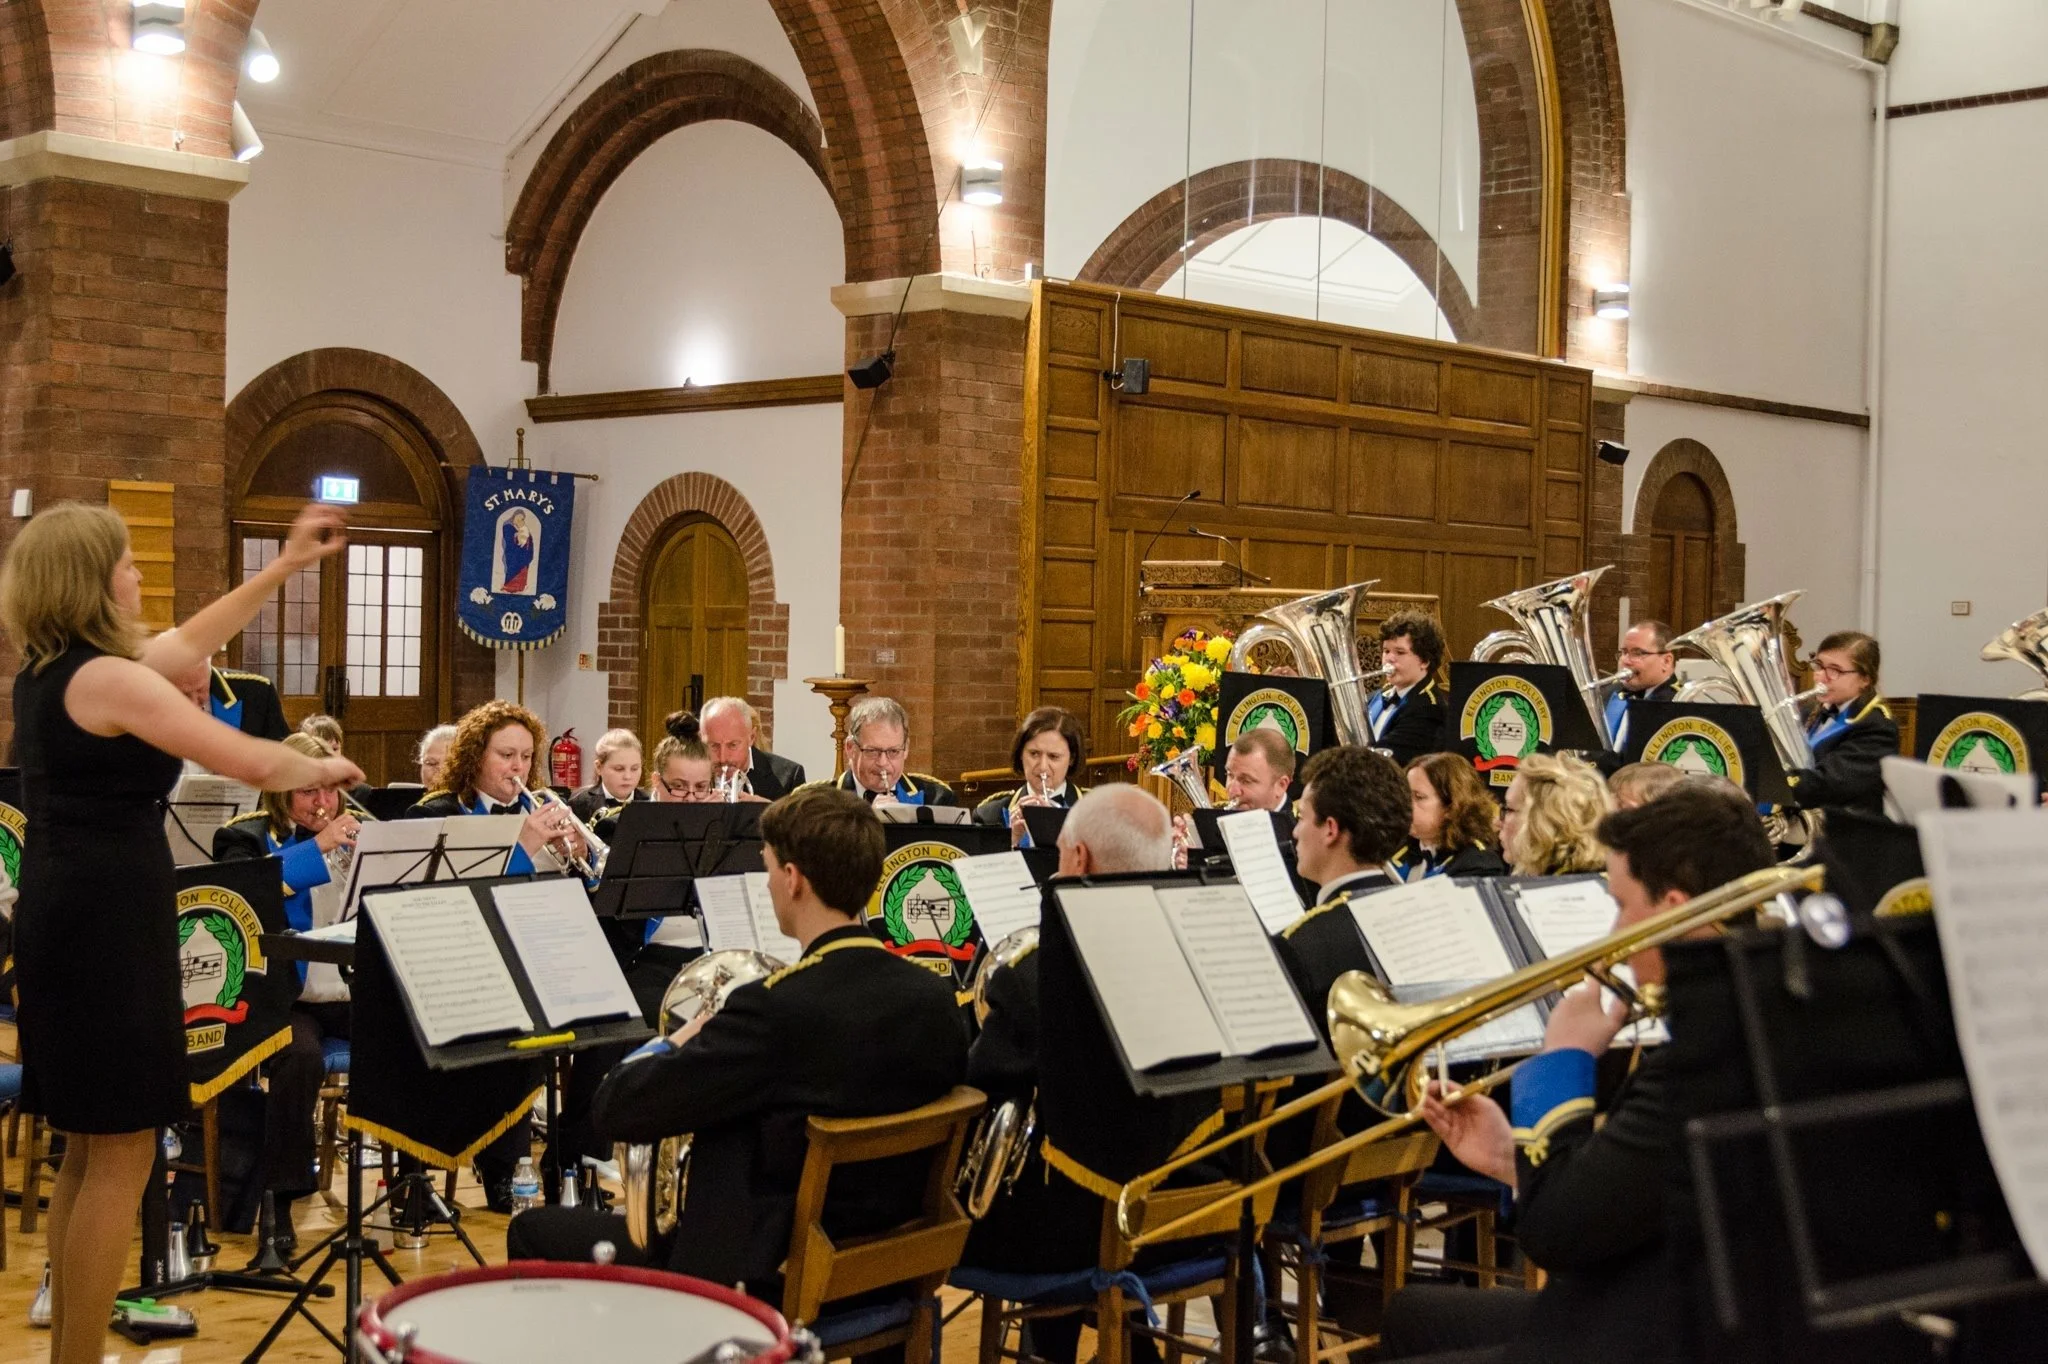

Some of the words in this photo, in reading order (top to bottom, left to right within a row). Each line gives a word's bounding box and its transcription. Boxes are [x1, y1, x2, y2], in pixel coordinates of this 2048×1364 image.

[1232, 692, 1272, 726] ELLINGTON
[1277, 694, 1306, 731] COLLIERY
[1466, 680, 1509, 718] ELLINGTON
[1515, 681, 1548, 720] COLLIERY
[1699, 723, 1738, 766] COLLIERY
[1493, 773, 1513, 783] BAN
[209, 891, 260, 938] COLLIERY
[186, 1029, 222, 1048] BAND
